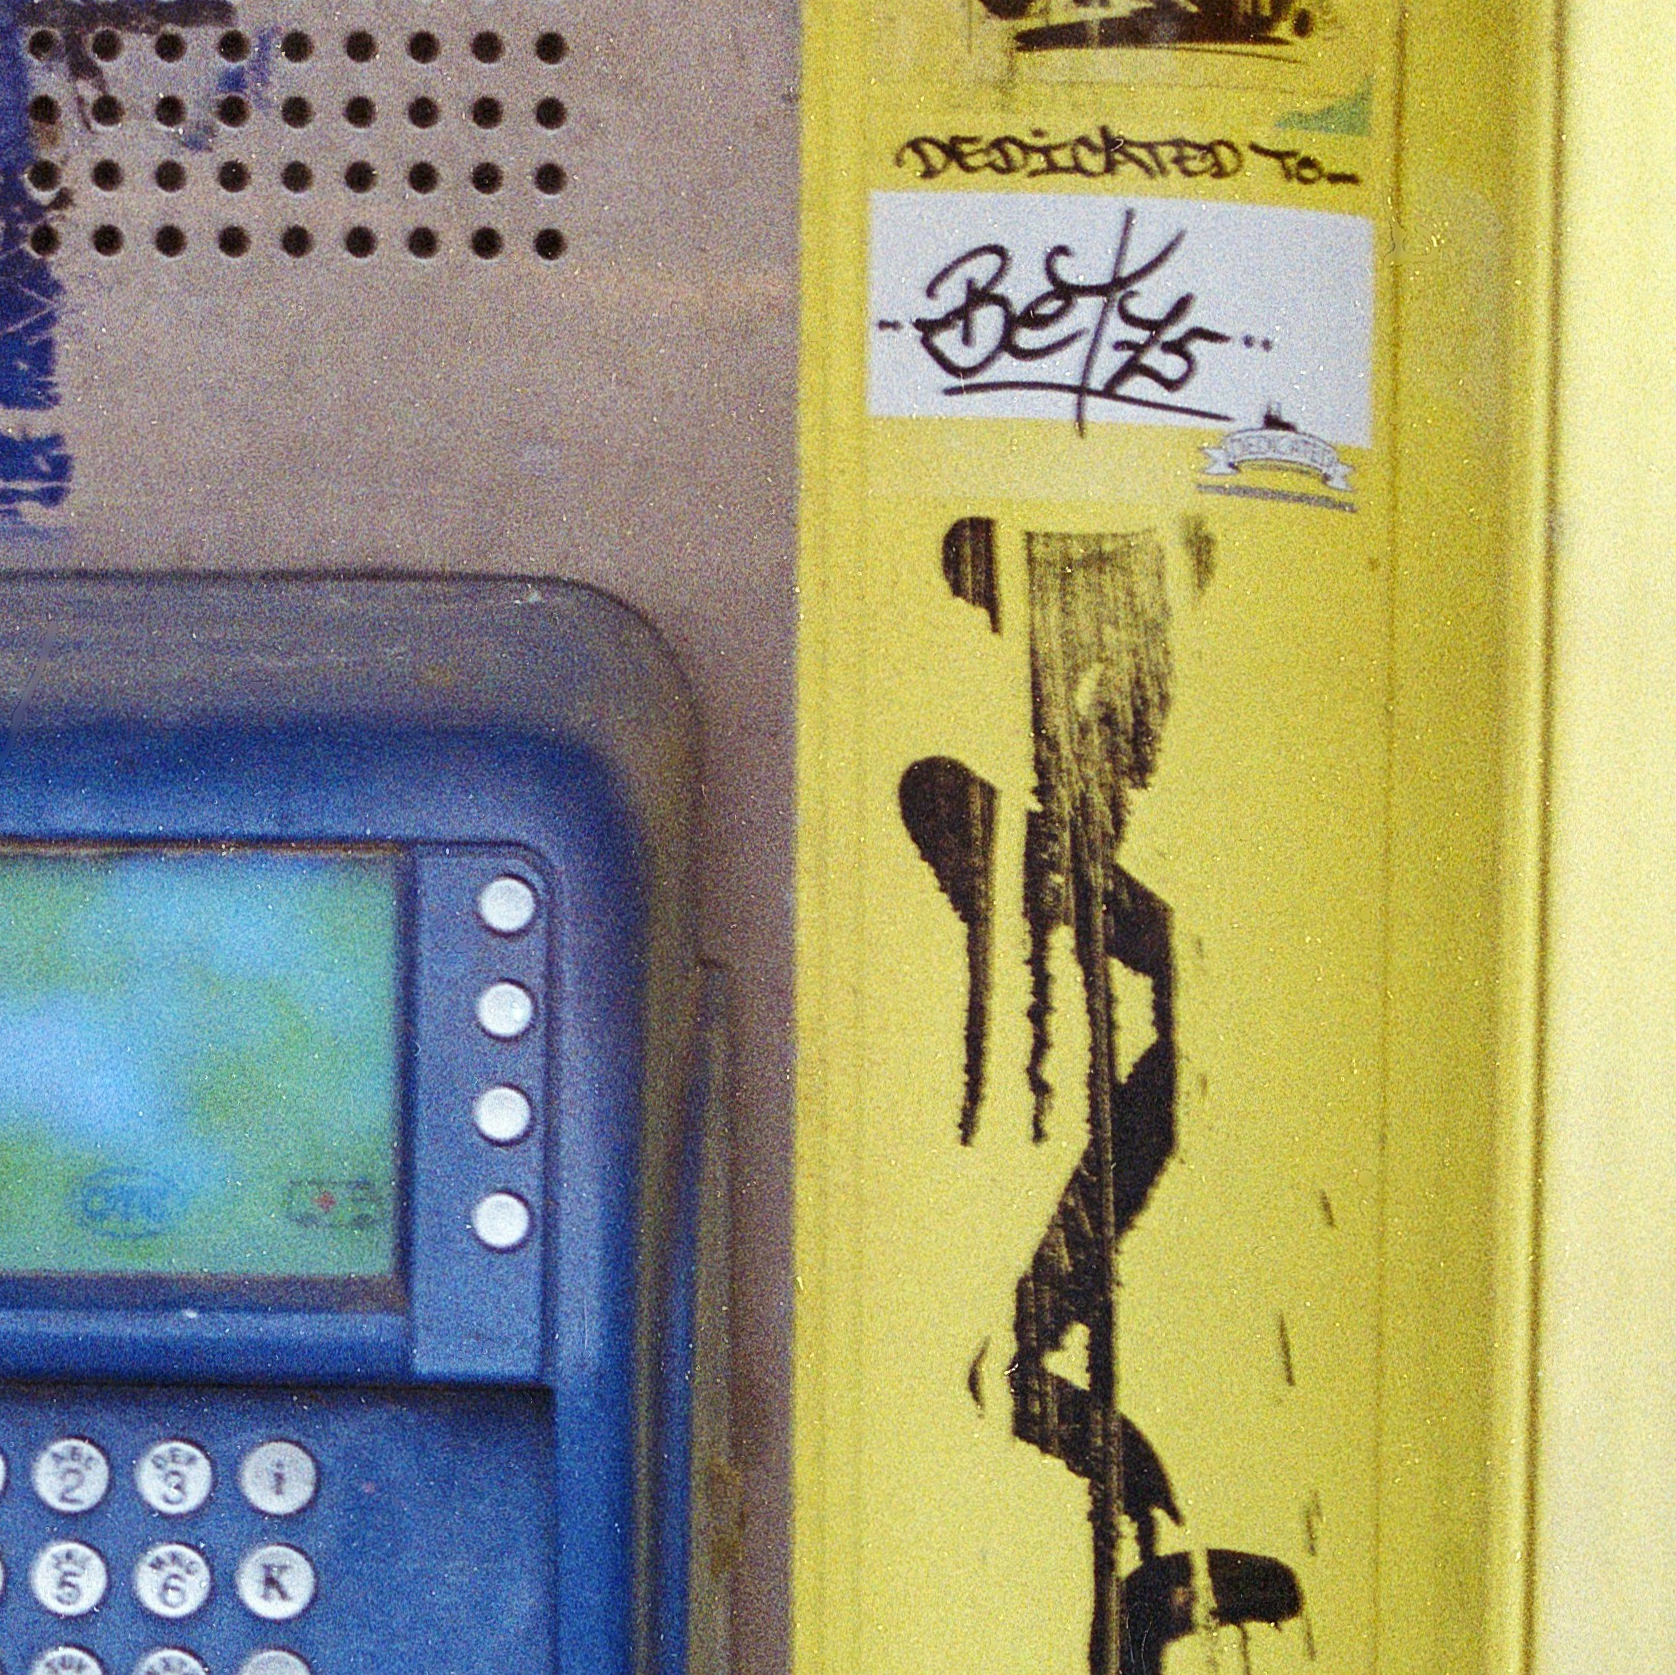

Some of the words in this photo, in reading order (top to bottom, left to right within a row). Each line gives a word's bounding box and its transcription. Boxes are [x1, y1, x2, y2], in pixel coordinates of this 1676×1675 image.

[57, 1466, 85, 1505] 2
[161, 1470, 188, 1505] 3
[270, 1460, 287, 1498] i
[55, 1570, 84, 1606] 5
[159, 1573, 188, 1609] 6
[260, 1563, 293, 1601] K
